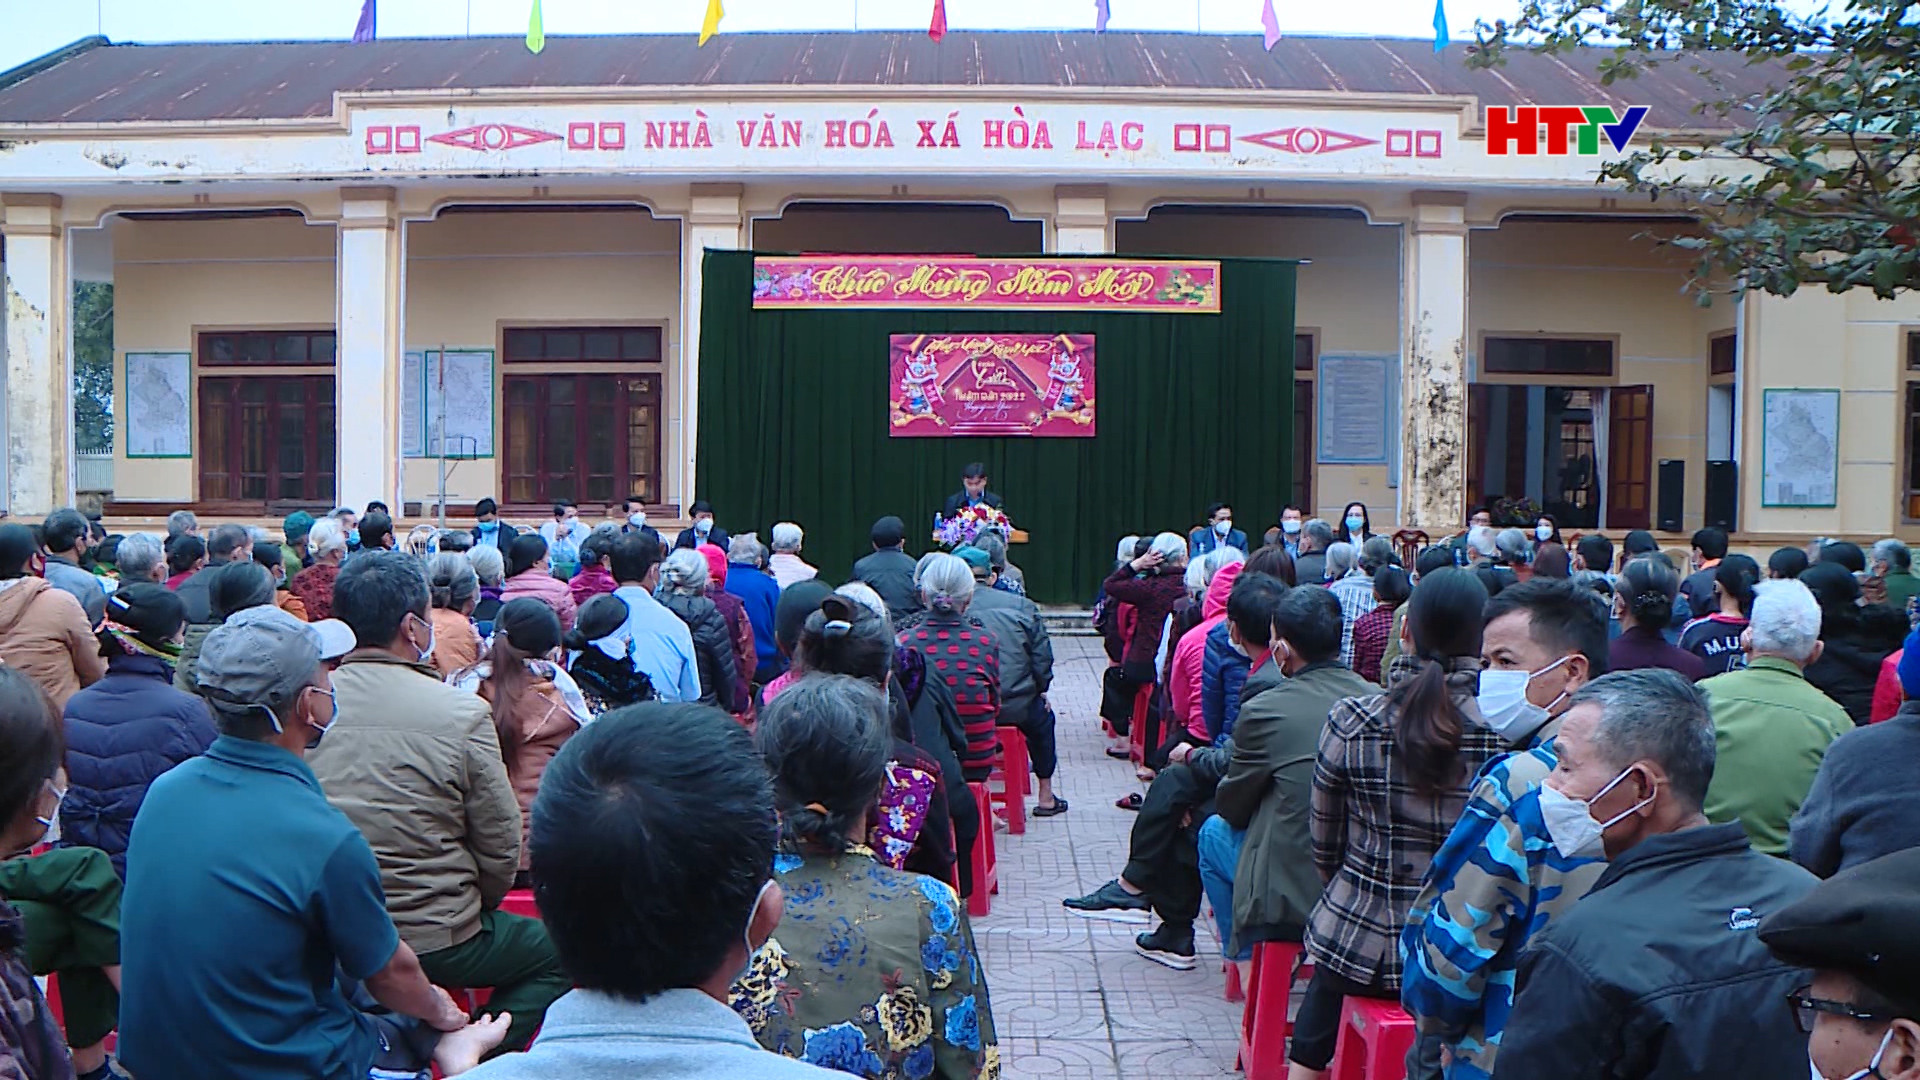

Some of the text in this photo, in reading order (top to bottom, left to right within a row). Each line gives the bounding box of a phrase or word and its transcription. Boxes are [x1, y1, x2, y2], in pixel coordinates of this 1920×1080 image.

[645, 109, 713, 149] NHÀ
[737, 112, 802, 148] VĂN
[825, 109, 894, 148] HÓA
[983, 106, 1053, 149] HÒA
[1075, 120, 1144, 158] LẠC
[812, 266, 891, 299] Chúc
[997, 266, 1073, 297] Năm
[1078, 267, 1154, 301] Mới
